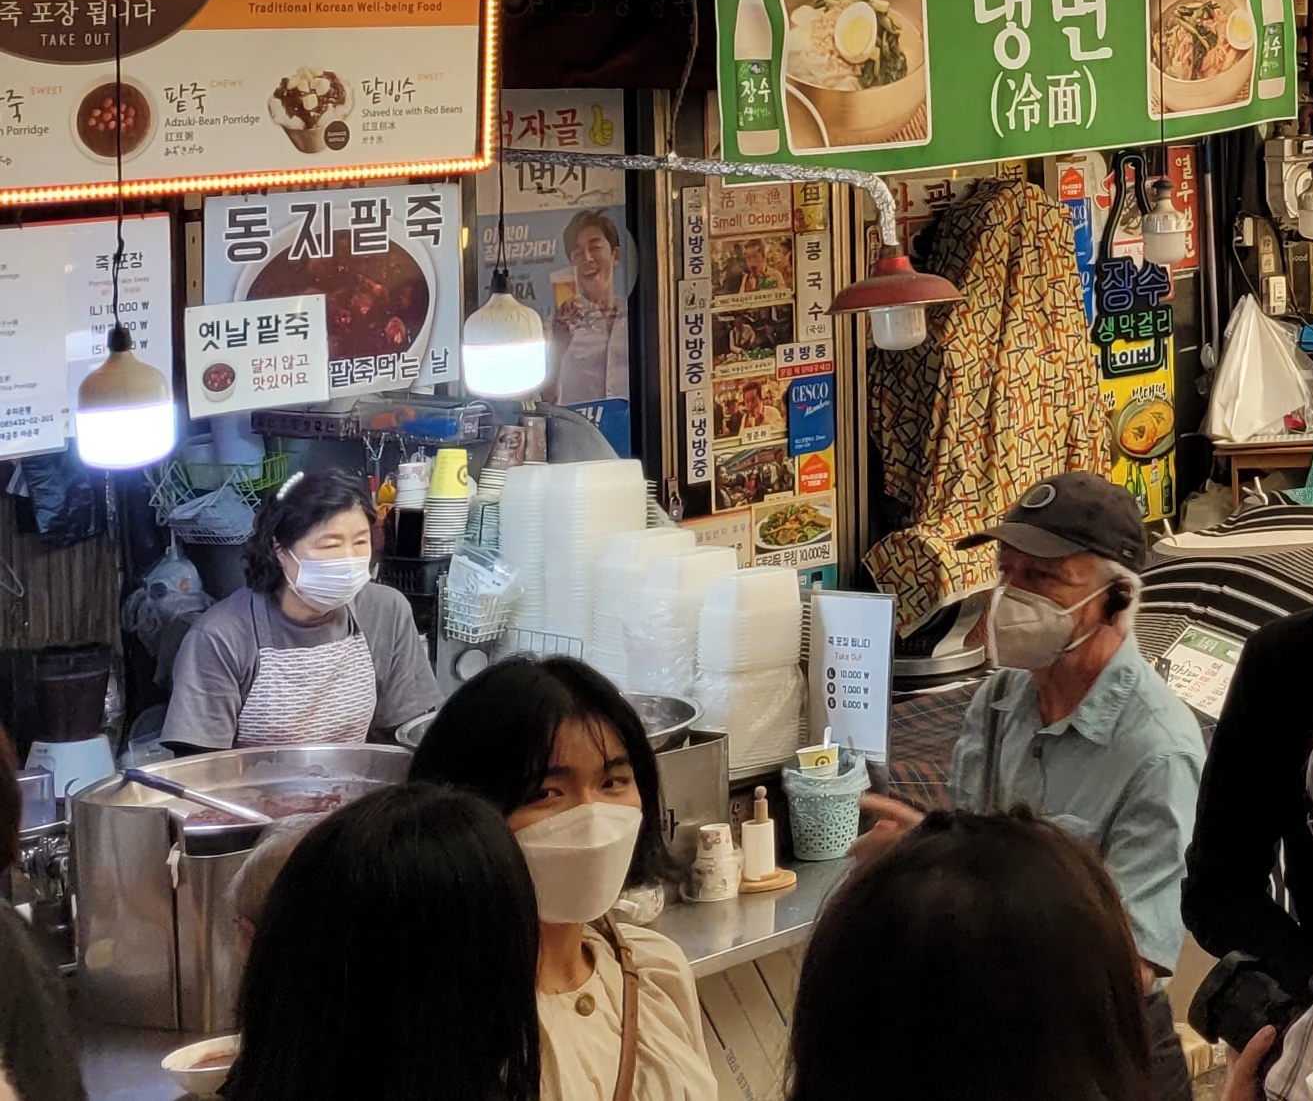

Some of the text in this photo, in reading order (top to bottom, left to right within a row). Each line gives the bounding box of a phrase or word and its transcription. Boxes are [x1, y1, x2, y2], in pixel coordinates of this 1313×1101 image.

[29, 0, 80, 27] 포장
[249, 0, 443, 14] Traditional Korean Well-being Food
[41, 32, 112, 47] TAKE OUT
[164, 82, 207, 115] 팥죽
[361, 76, 416, 105] 팥빙수
[741, 77, 771, 103] 장수
[164, 114, 260, 128] Adzuki-Bean Porridge
[362, 105, 463, 118] Shaved Ice with Red Beans
[6, 124, 50, 137] Porridge
[712, 211, 790, 229] Small Octopus
[687, 215, 705, 275] 냉방중
[1101, 261, 1170, 313] 장수
[199, 311, 310, 352] 옛날 팥죽
[1097, 308, 1174, 343] 생막걸리
[430, 347, 450, 375] 날
[684, 313, 706, 385] 냉방중
[783, 344, 827, 363] 냉방중
[251, 353, 310, 371] 달지 않고
[252, 372, 309, 392] 맛있어요
[791, 381, 829, 404] CESCO
[1131, 383, 1167, 404] 빈대떡
[690, 416, 710, 478] 냉방중
